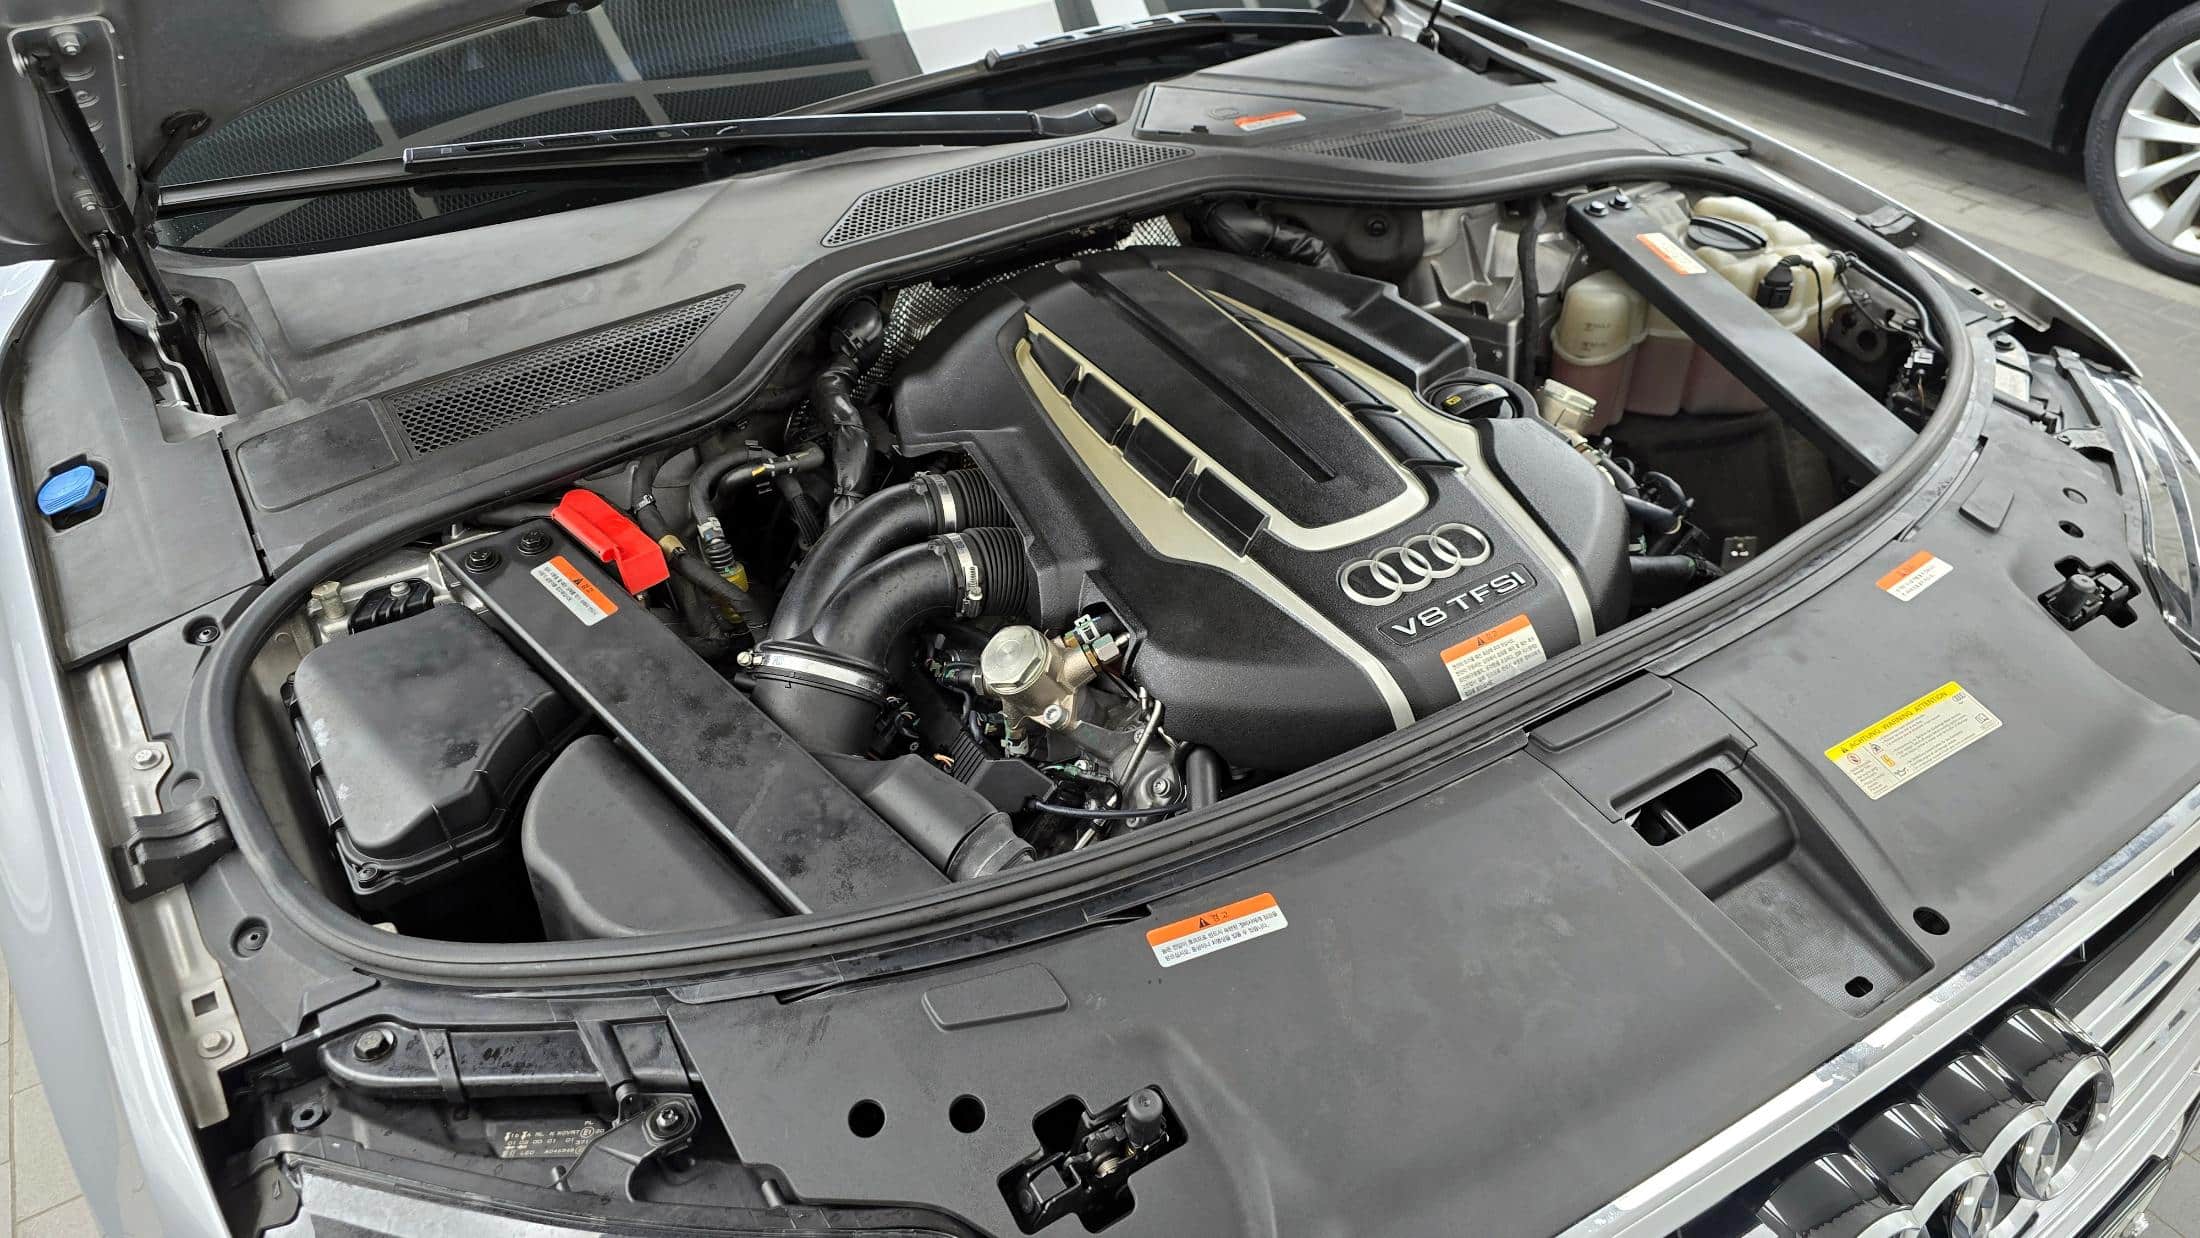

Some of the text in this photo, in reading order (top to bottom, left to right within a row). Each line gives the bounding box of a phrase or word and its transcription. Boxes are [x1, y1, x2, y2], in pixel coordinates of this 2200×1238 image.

[1391, 571, 1526, 636] V8 TFSI
[1849, 728, 1882, 750] ACHTUNG
[1883, 710, 1914, 730] WARNING
[1915, 691, 1948, 713] ATTENTION
